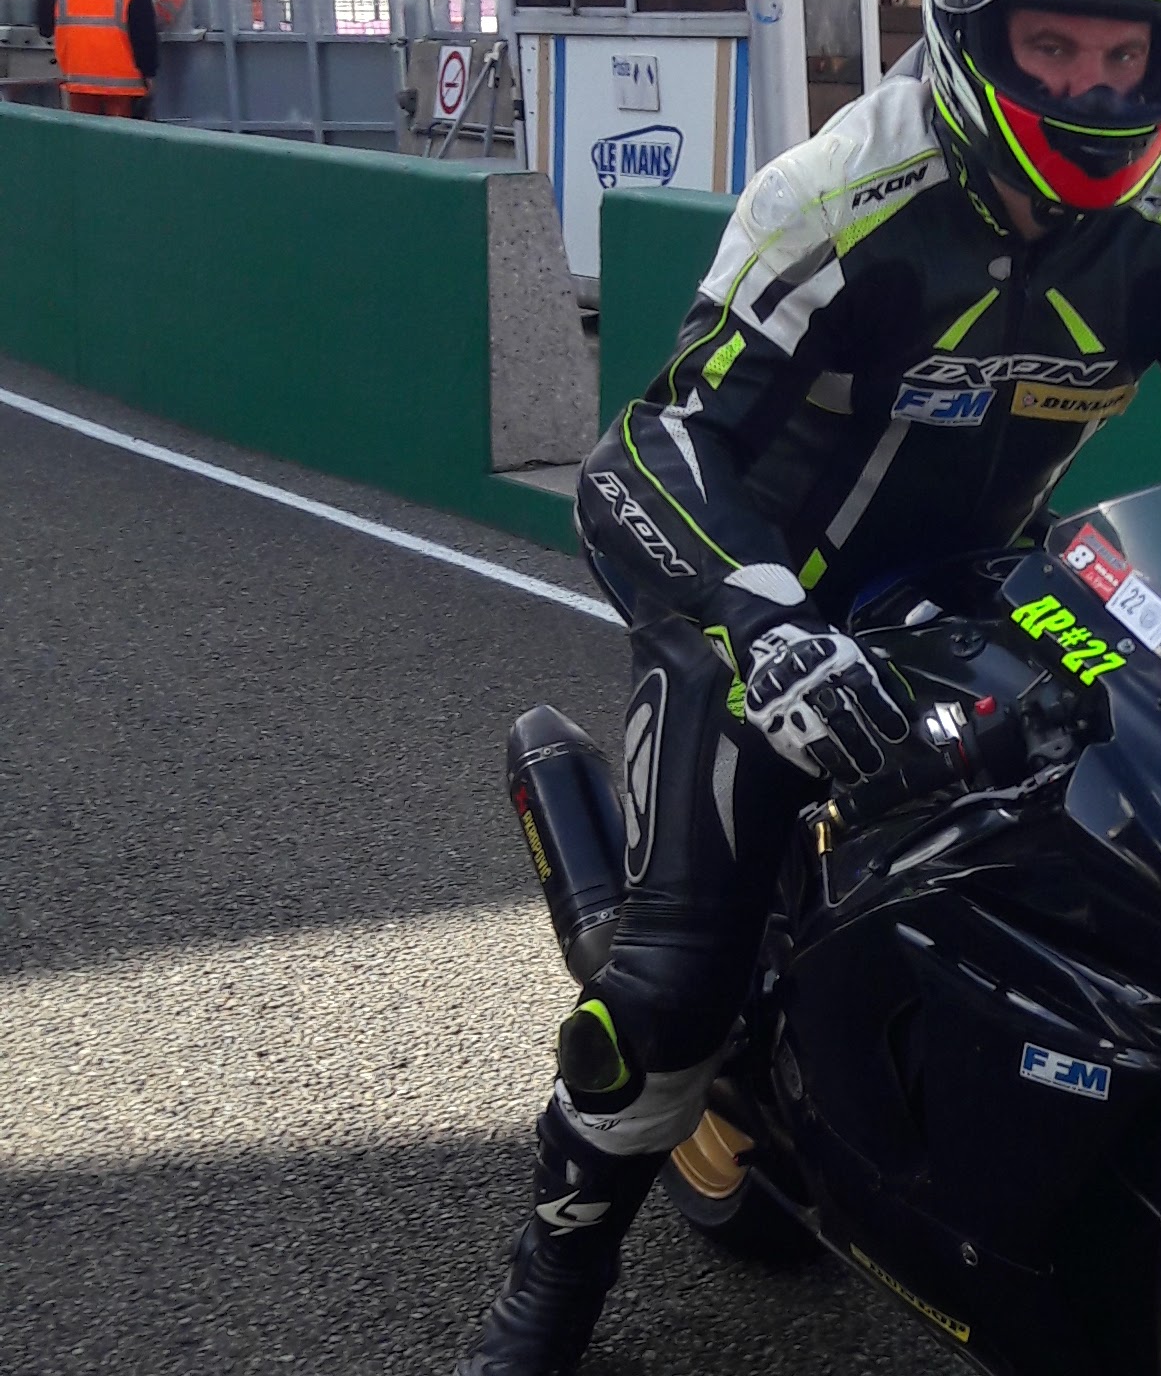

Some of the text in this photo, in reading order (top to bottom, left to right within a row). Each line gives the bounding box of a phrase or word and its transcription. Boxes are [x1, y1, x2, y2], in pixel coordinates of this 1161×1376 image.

[600, 142, 673, 178] LE MANS
[851, 163, 929, 210] IXON
[902, 354, 1119, 389] IXON
[1040, 393, 1126, 413] DUNLOP
[587, 471, 698, 578] IXON
[1066, 542, 1096, 571] 8
[1120, 587, 1147, 616] 22
[1010, 594, 1128, 687] AP#27
